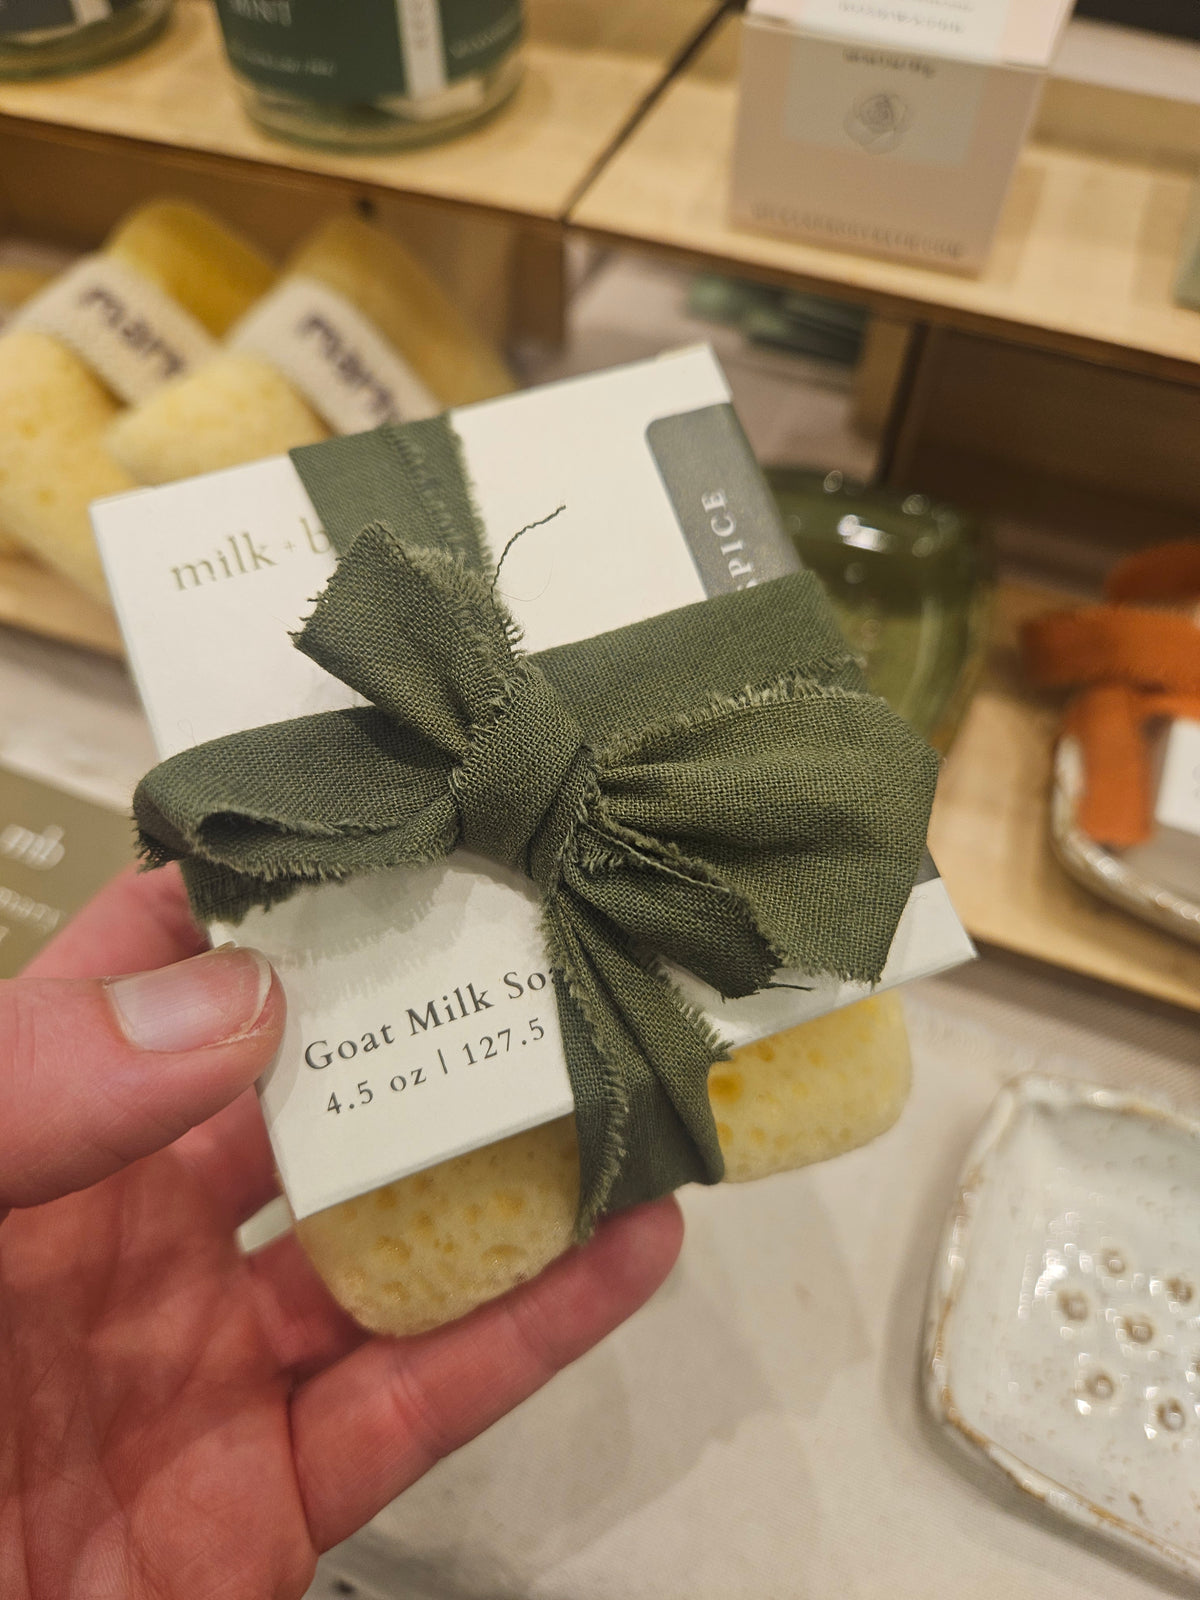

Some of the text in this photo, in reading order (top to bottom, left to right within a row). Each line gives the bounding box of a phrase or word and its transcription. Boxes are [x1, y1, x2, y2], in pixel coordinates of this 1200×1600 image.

[171, 531, 277, 591] milk
[304, 968, 556, 1070] Goat Milk So
[326, 1080, 374, 1115] 4.5
[389, 1066, 427, 1092] oz
[462, 1017, 545, 1066] 127.5
